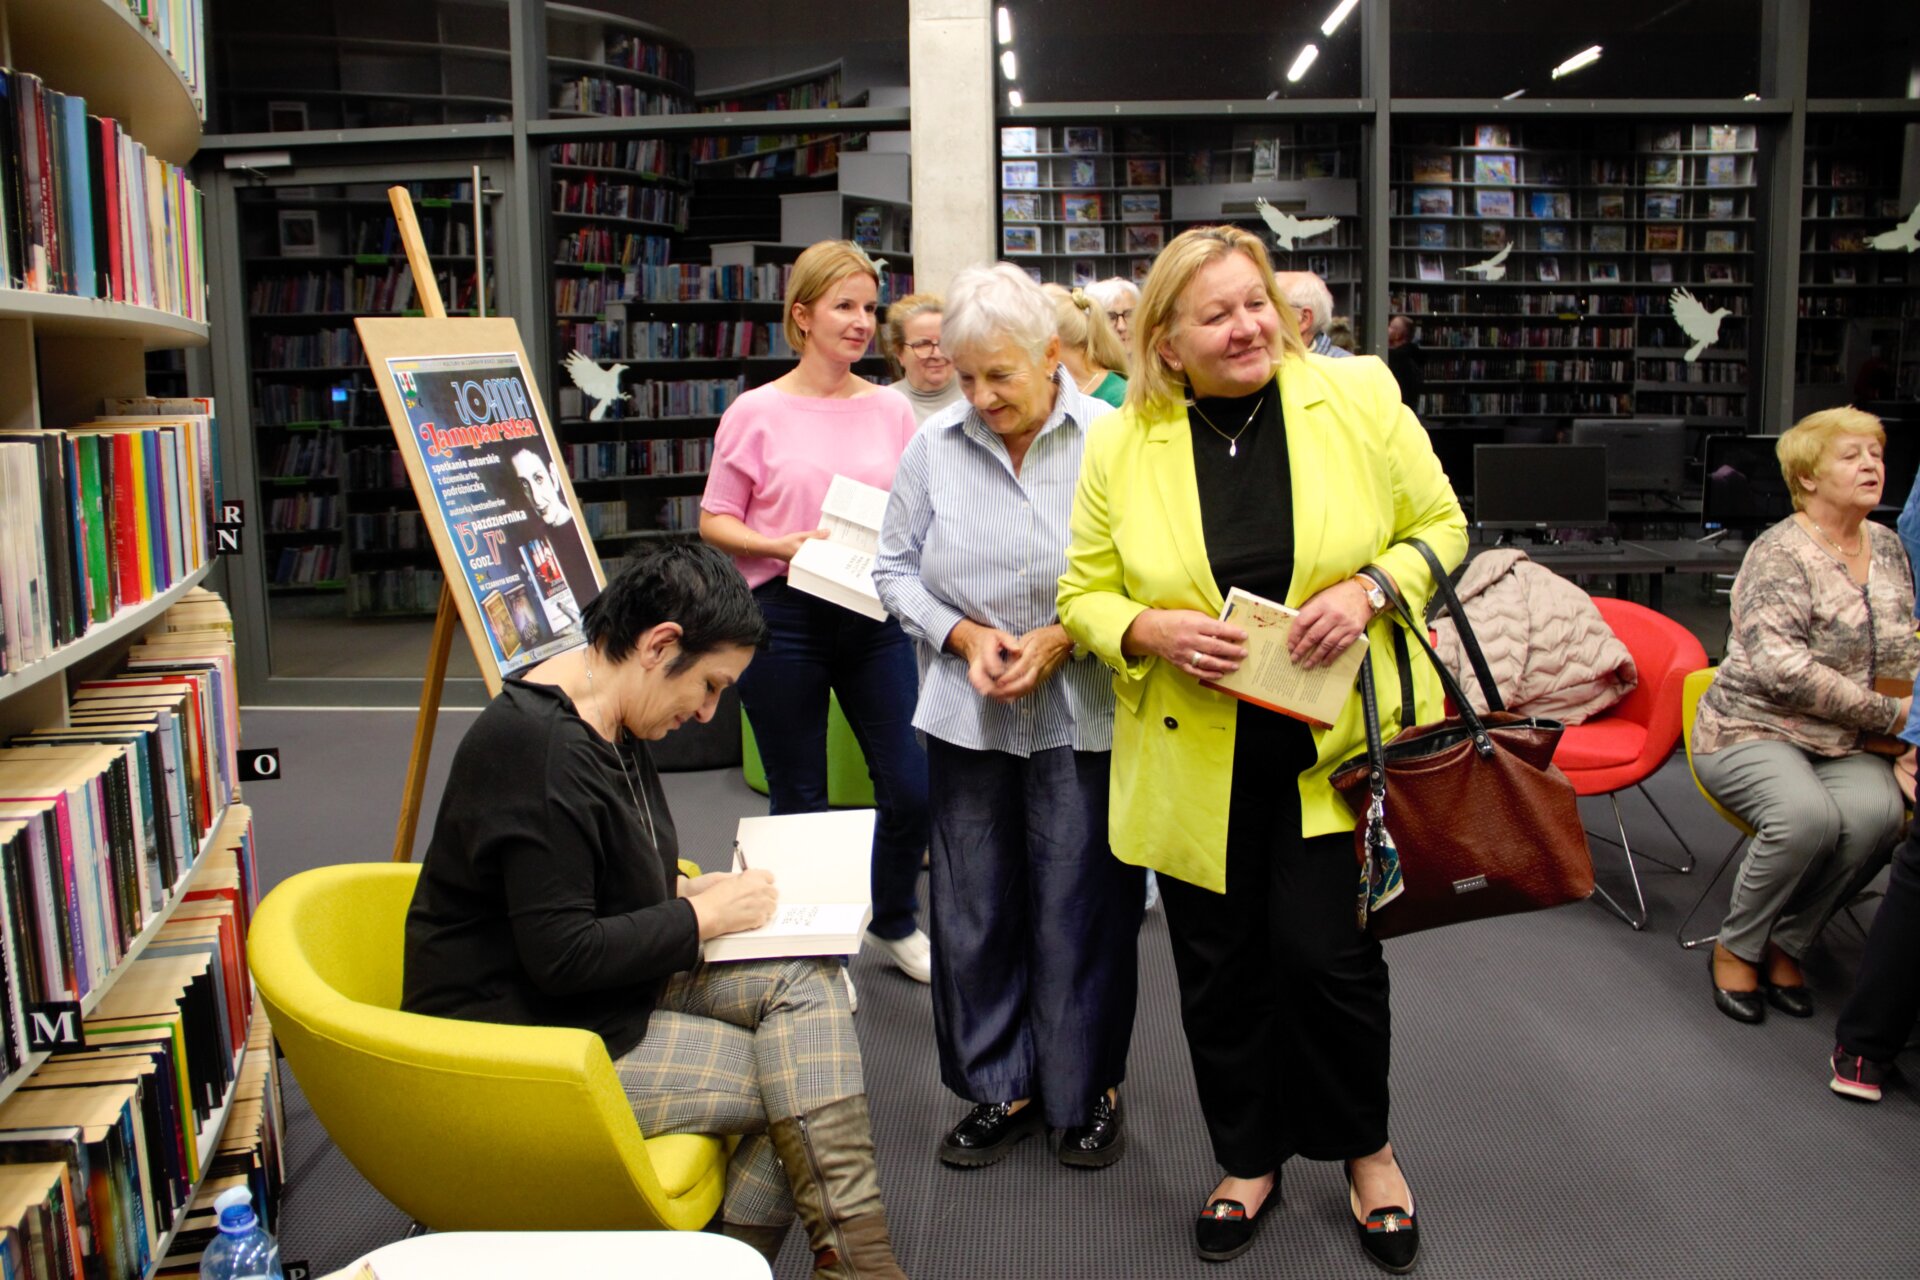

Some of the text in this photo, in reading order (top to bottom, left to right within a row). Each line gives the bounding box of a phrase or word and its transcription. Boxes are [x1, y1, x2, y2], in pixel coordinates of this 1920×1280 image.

[451, 377, 532, 425] JOANNA
[432, 453, 501, 475] spotkanie autorskie
[223, 505, 242, 524] R
[216, 528, 239, 551] N
[453, 521, 478, 557] 15
[253, 754, 277, 775] O
[29, 1011, 79, 1044] M
